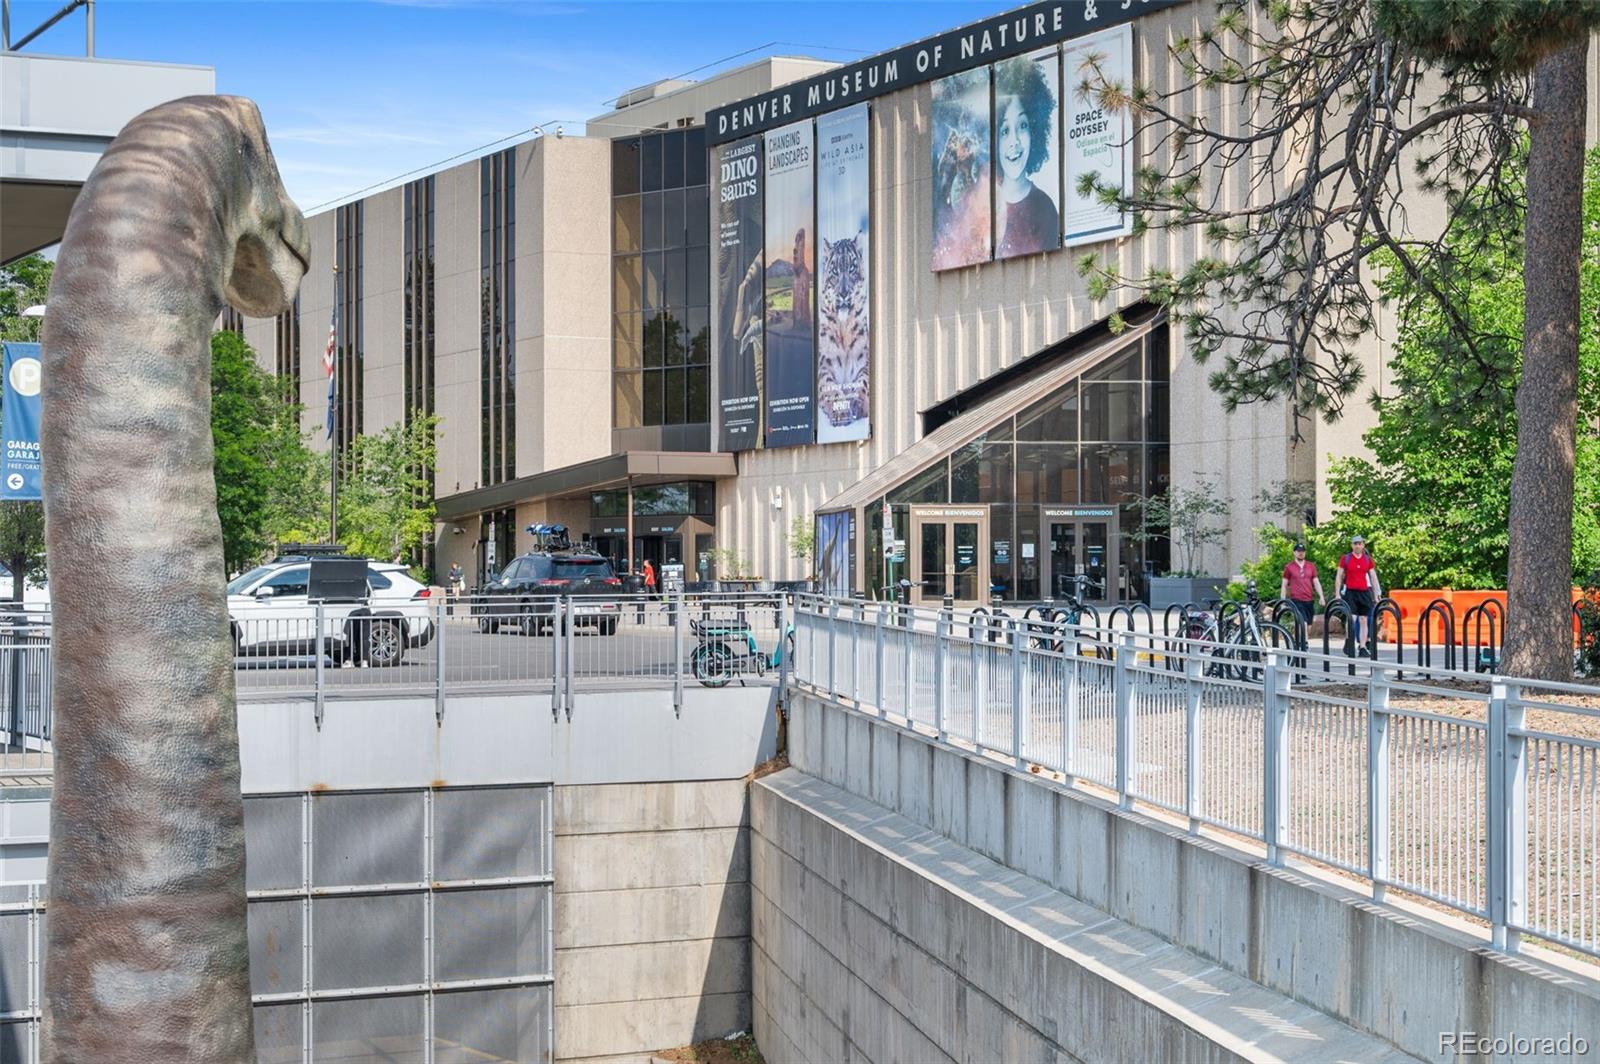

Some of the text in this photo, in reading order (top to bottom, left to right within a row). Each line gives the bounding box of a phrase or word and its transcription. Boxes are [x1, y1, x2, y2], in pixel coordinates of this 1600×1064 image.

[719, 94, 792, 134] DENVER
[807, 59, 898, 107] MUSEUM
[916, 45, 942, 73] OF
[960, 6, 1062, 60] NATURE
[1084, 0, 1098, 21] &
[1075, 108, 1103, 125] SPACE
[1069, 120, 1109, 139] ODYSSEY
[730, 143, 756, 158] LARGEST
[769, 130, 801, 153] CHANGING
[820, 143, 864, 160] WILD ASIA
[769, 146, 809, 170] LANDSCAPES
[721, 155, 758, 184] DINO
[720, 179, 757, 202] saurs
[20, 364, 41, 390] P
[7, 440, 40, 450] GARAG
[7, 450, 40, 460] GARAJ
